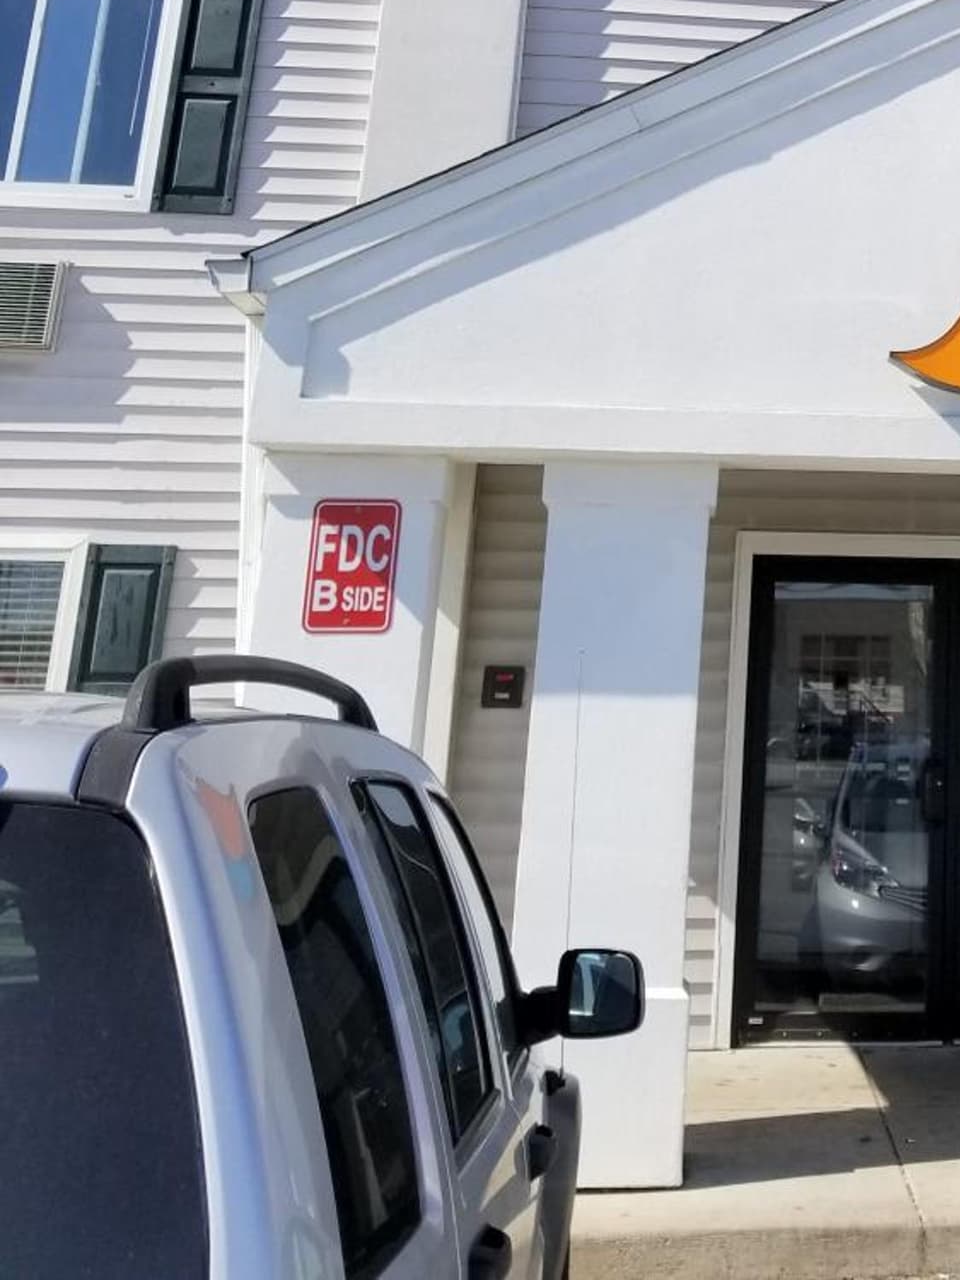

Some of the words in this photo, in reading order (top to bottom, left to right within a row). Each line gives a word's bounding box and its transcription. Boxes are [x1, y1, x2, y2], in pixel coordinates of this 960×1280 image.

[315, 524, 391, 572] FDC
[312, 579, 338, 612] B
[341, 586, 386, 612] SIDE
